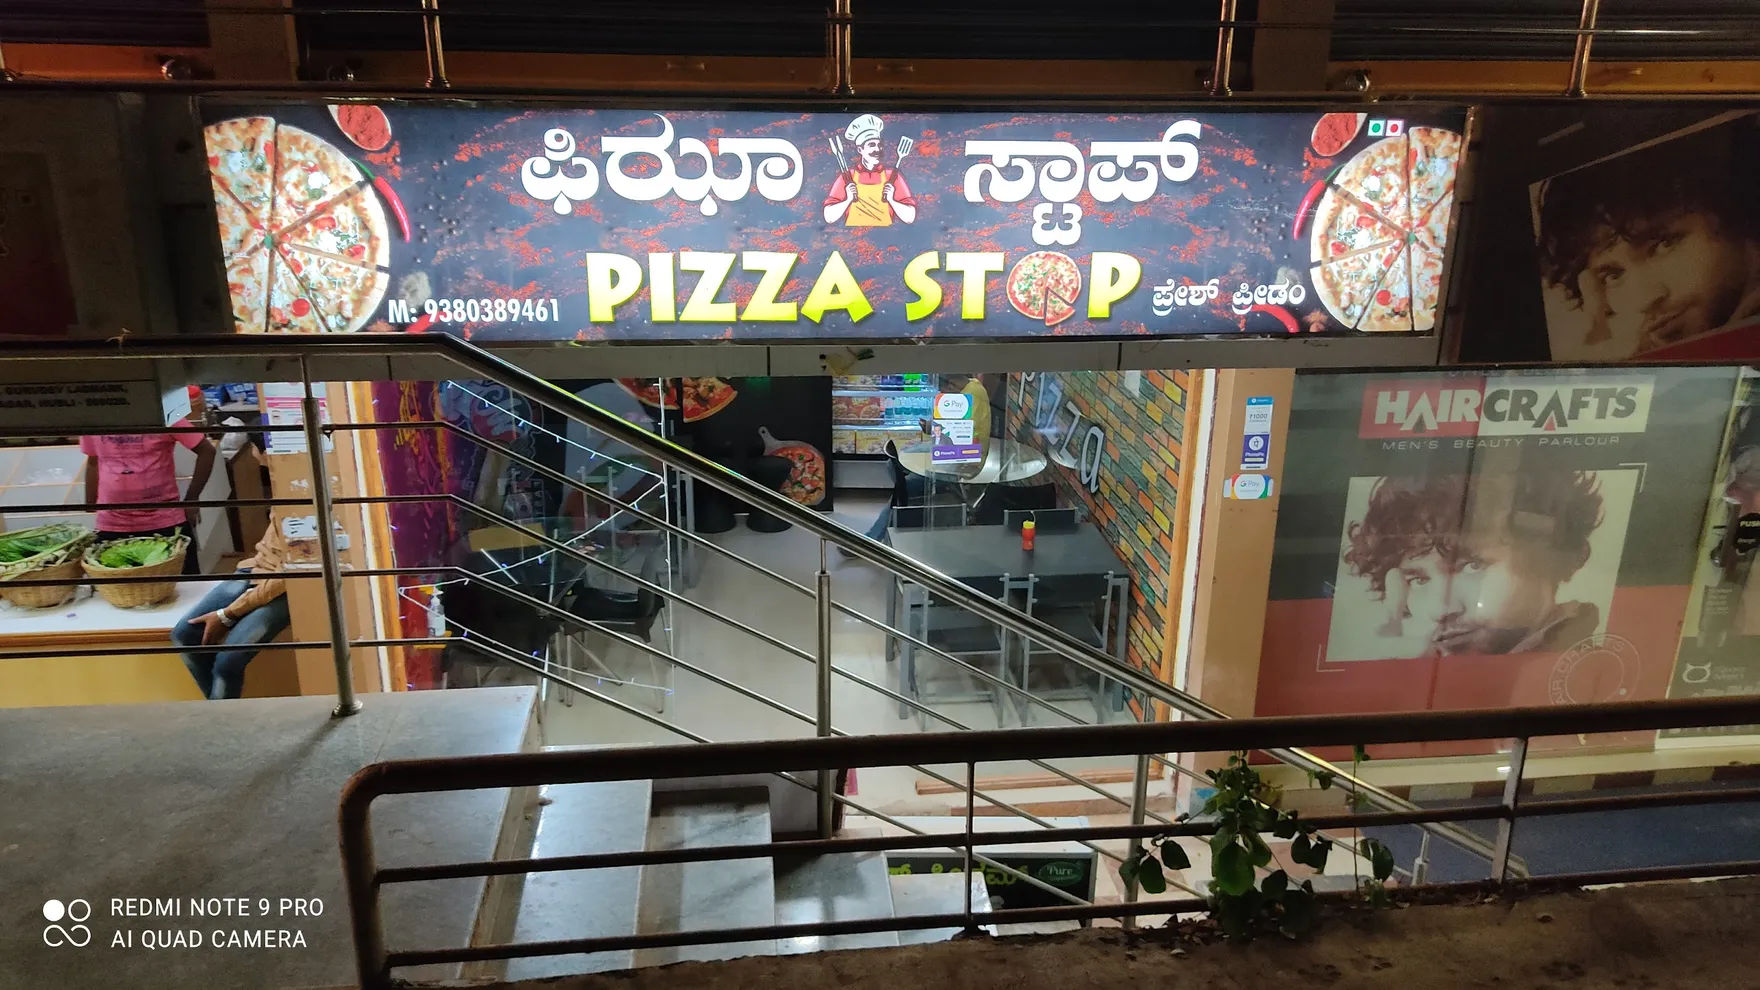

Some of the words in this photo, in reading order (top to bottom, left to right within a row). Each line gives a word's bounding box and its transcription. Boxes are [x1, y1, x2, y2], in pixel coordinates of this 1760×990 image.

[963, 119, 1202, 246] ಸ್ಟಾಪ್
[424, 298, 559, 323] 9380389461
[585, 250, 873, 324] PIZZA
[1382, 439, 1440, 450] MEN'S
[1453, 437, 1525, 449] BEAUTY
[1538, 435, 1621, 447] PARLOUR
